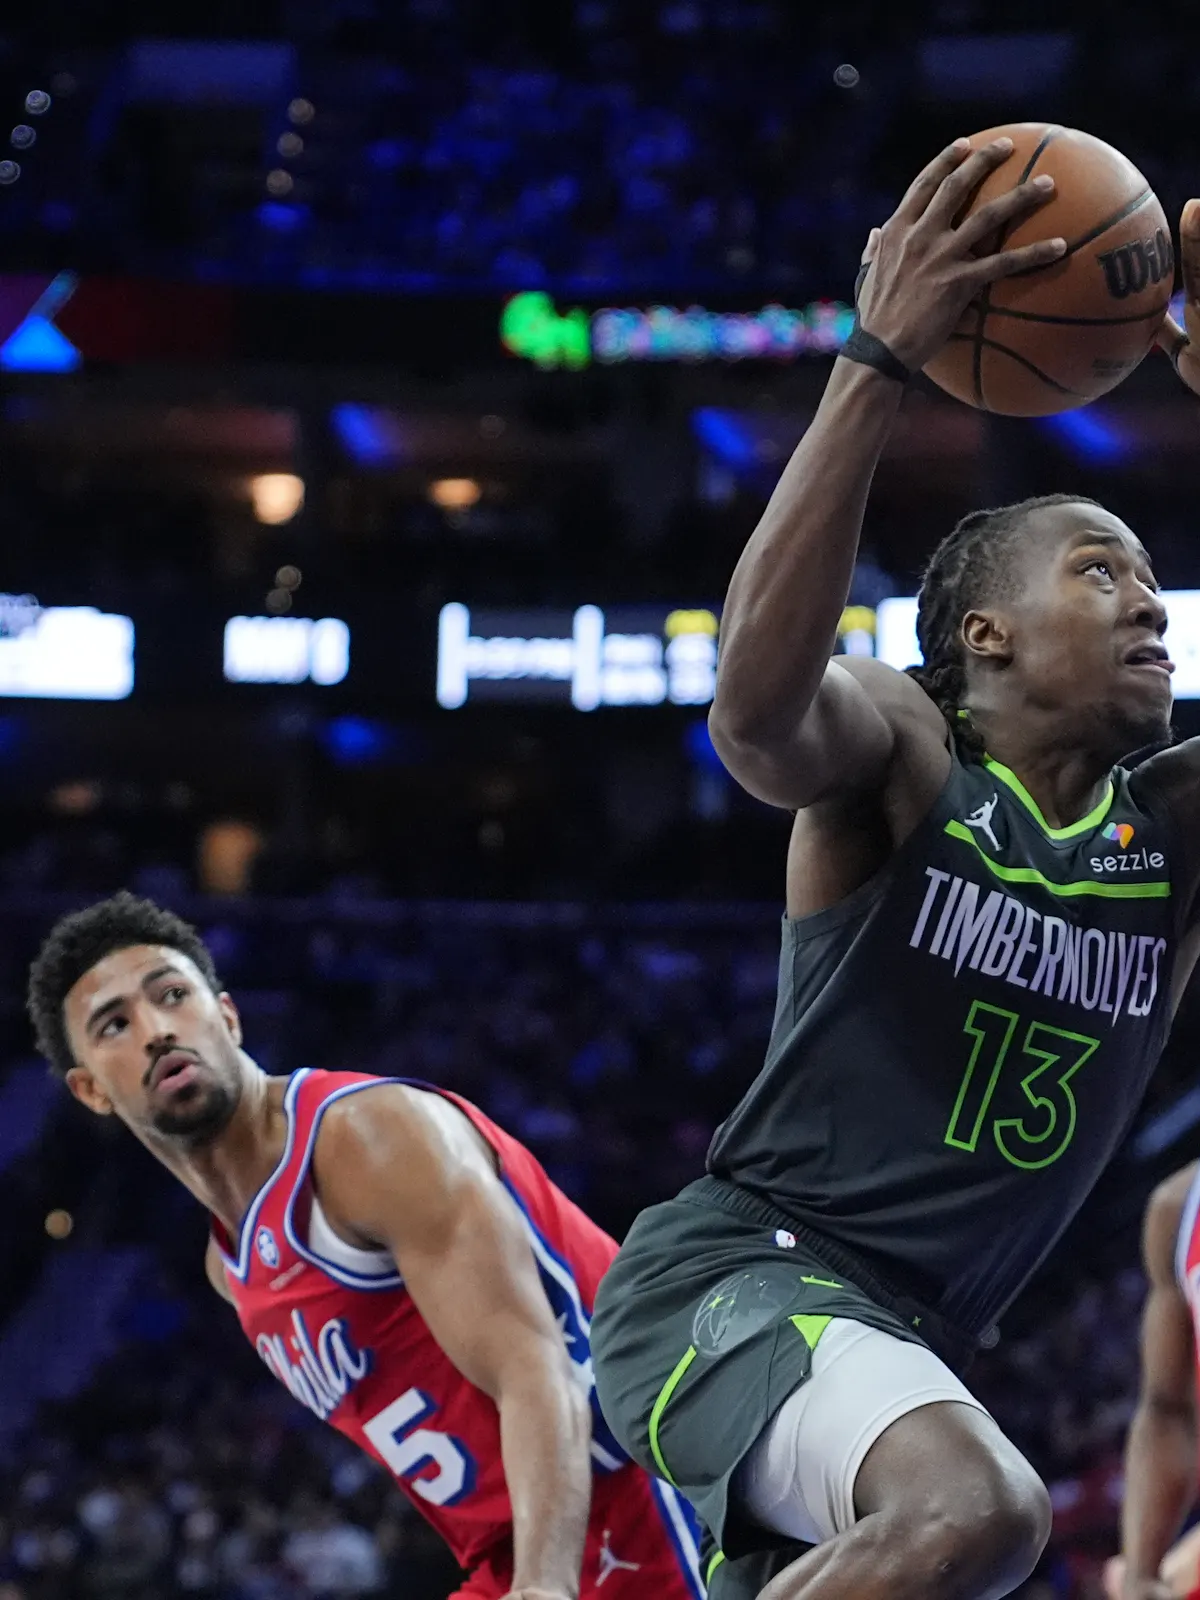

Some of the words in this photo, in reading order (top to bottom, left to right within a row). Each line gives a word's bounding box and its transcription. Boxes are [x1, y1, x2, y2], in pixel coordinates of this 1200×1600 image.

[1090, 847, 1165, 872] sezzle
[909, 865, 1166, 1027] TIMBERWOLVES
[944, 999, 1100, 1169] 13
[362, 1386, 474, 1505] 5
